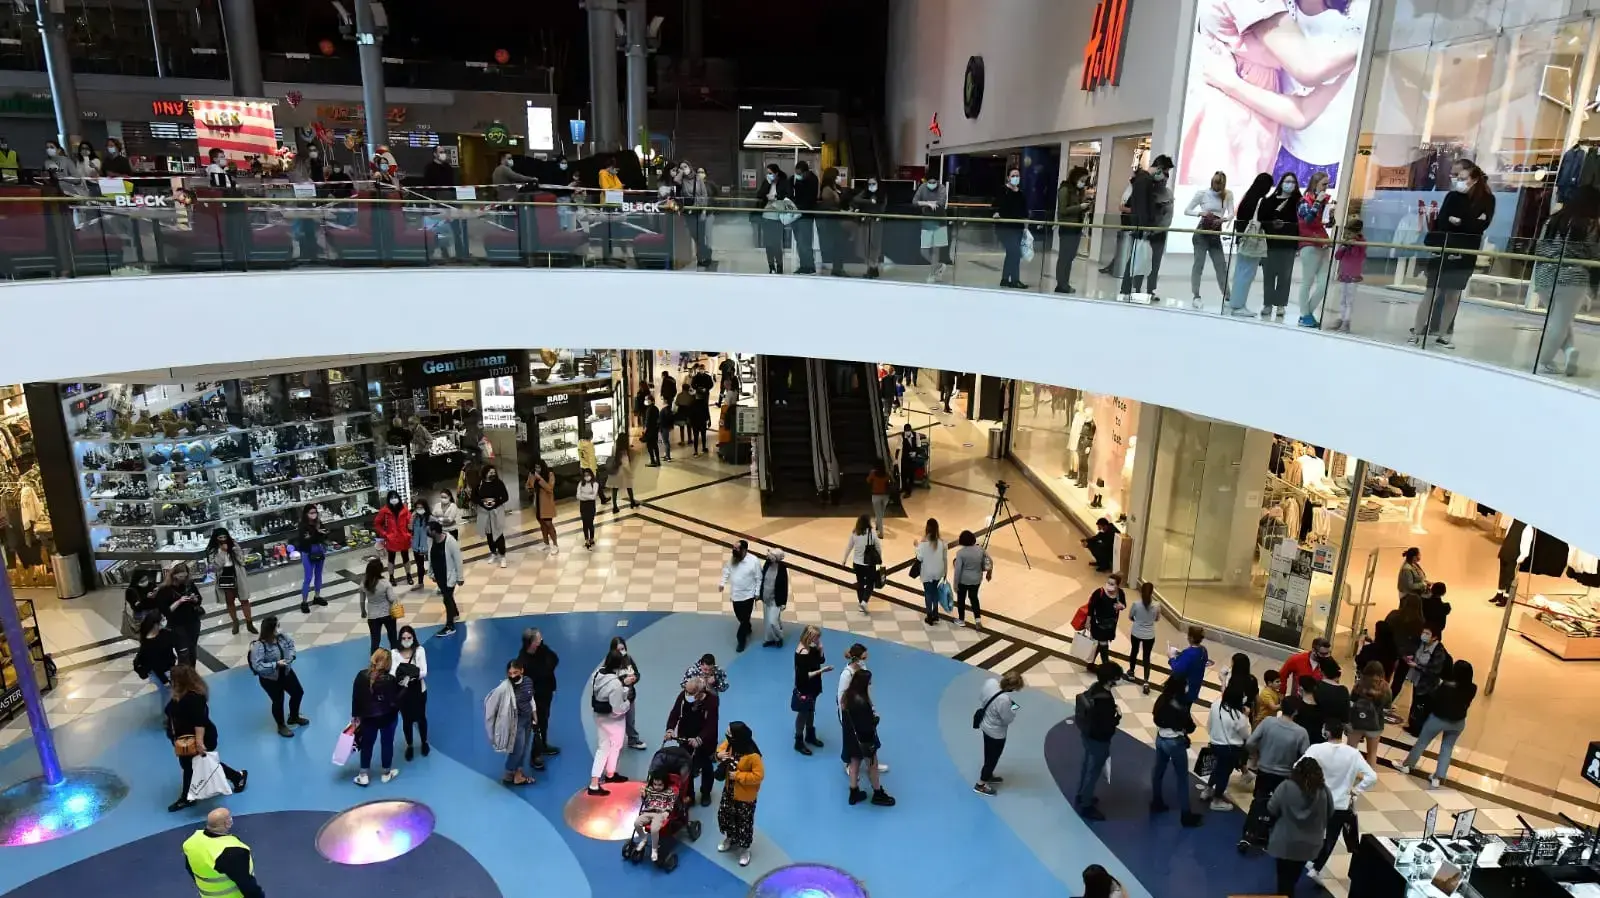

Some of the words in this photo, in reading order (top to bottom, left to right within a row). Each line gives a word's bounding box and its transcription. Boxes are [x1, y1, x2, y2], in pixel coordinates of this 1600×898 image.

[422, 354, 507, 374] Gentleman
[546, 393, 568, 403] RADO
[0, 689, 22, 711] ASTER
